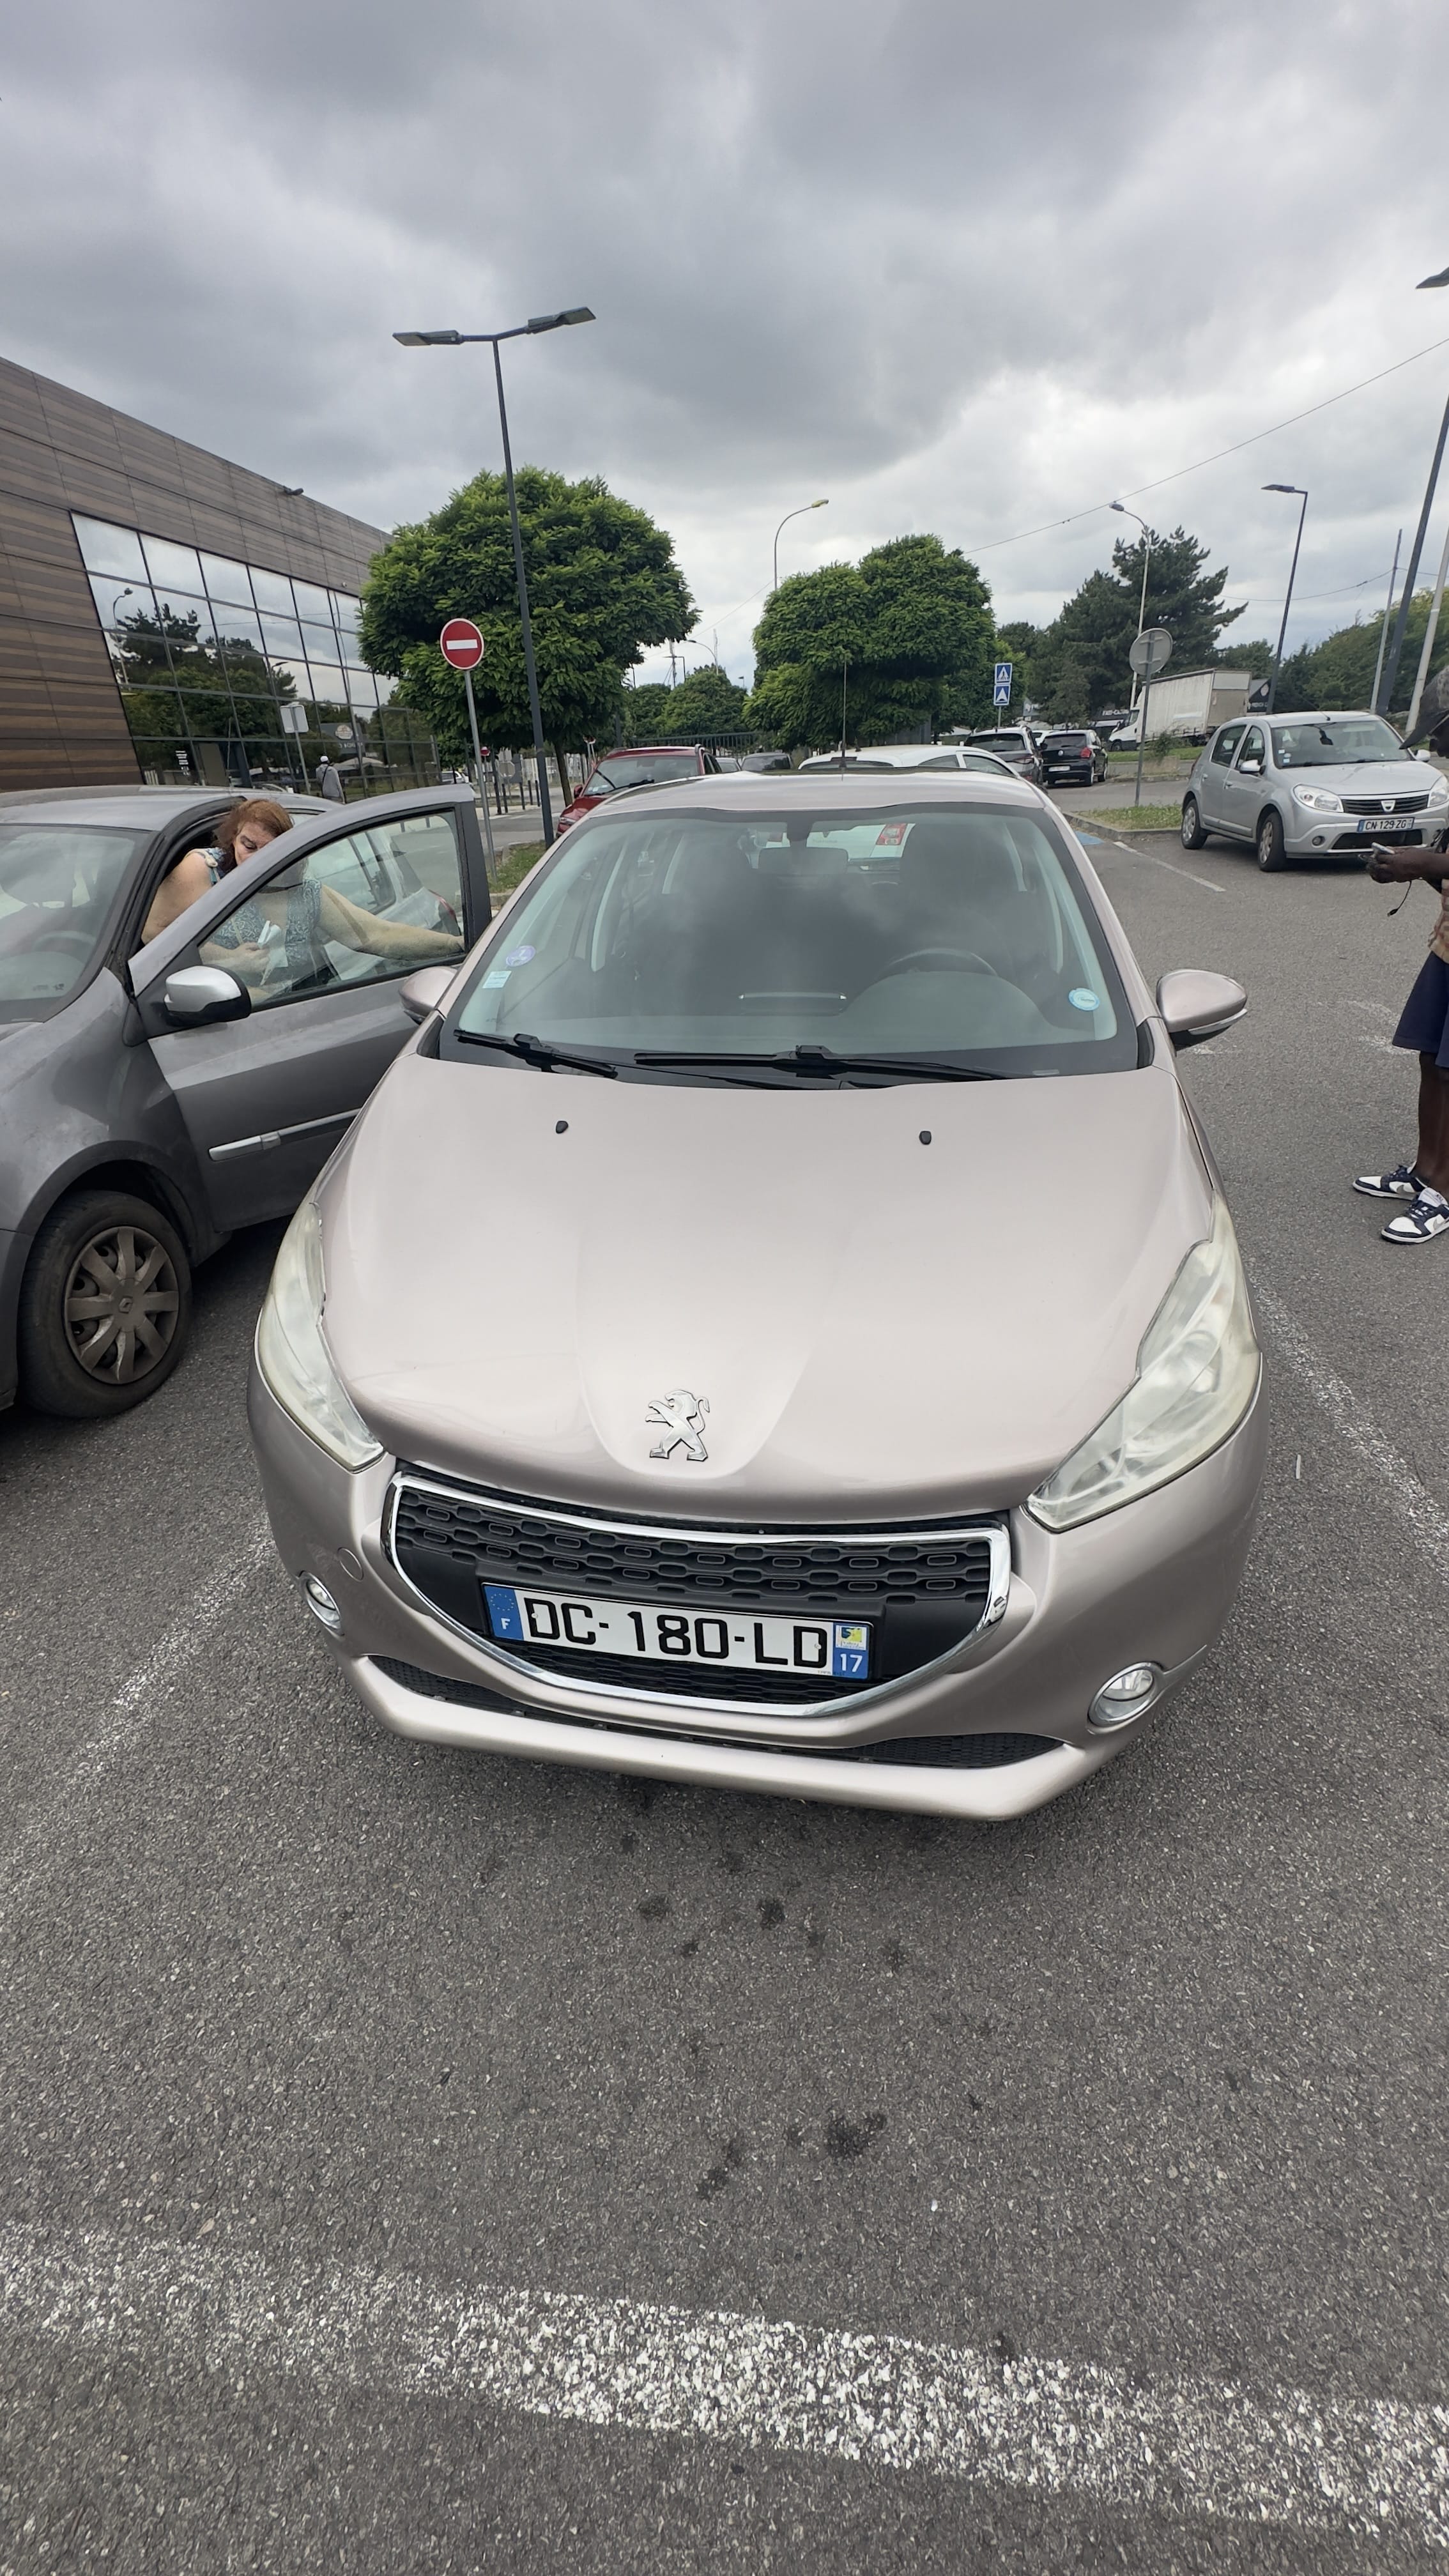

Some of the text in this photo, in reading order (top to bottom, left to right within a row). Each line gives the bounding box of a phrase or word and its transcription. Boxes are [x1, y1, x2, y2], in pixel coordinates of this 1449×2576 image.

[500, 1618, 510, 1630] F
[524, 1597, 827, 1669] DC-180-LD
[840, 1653, 862, 1672] 17
